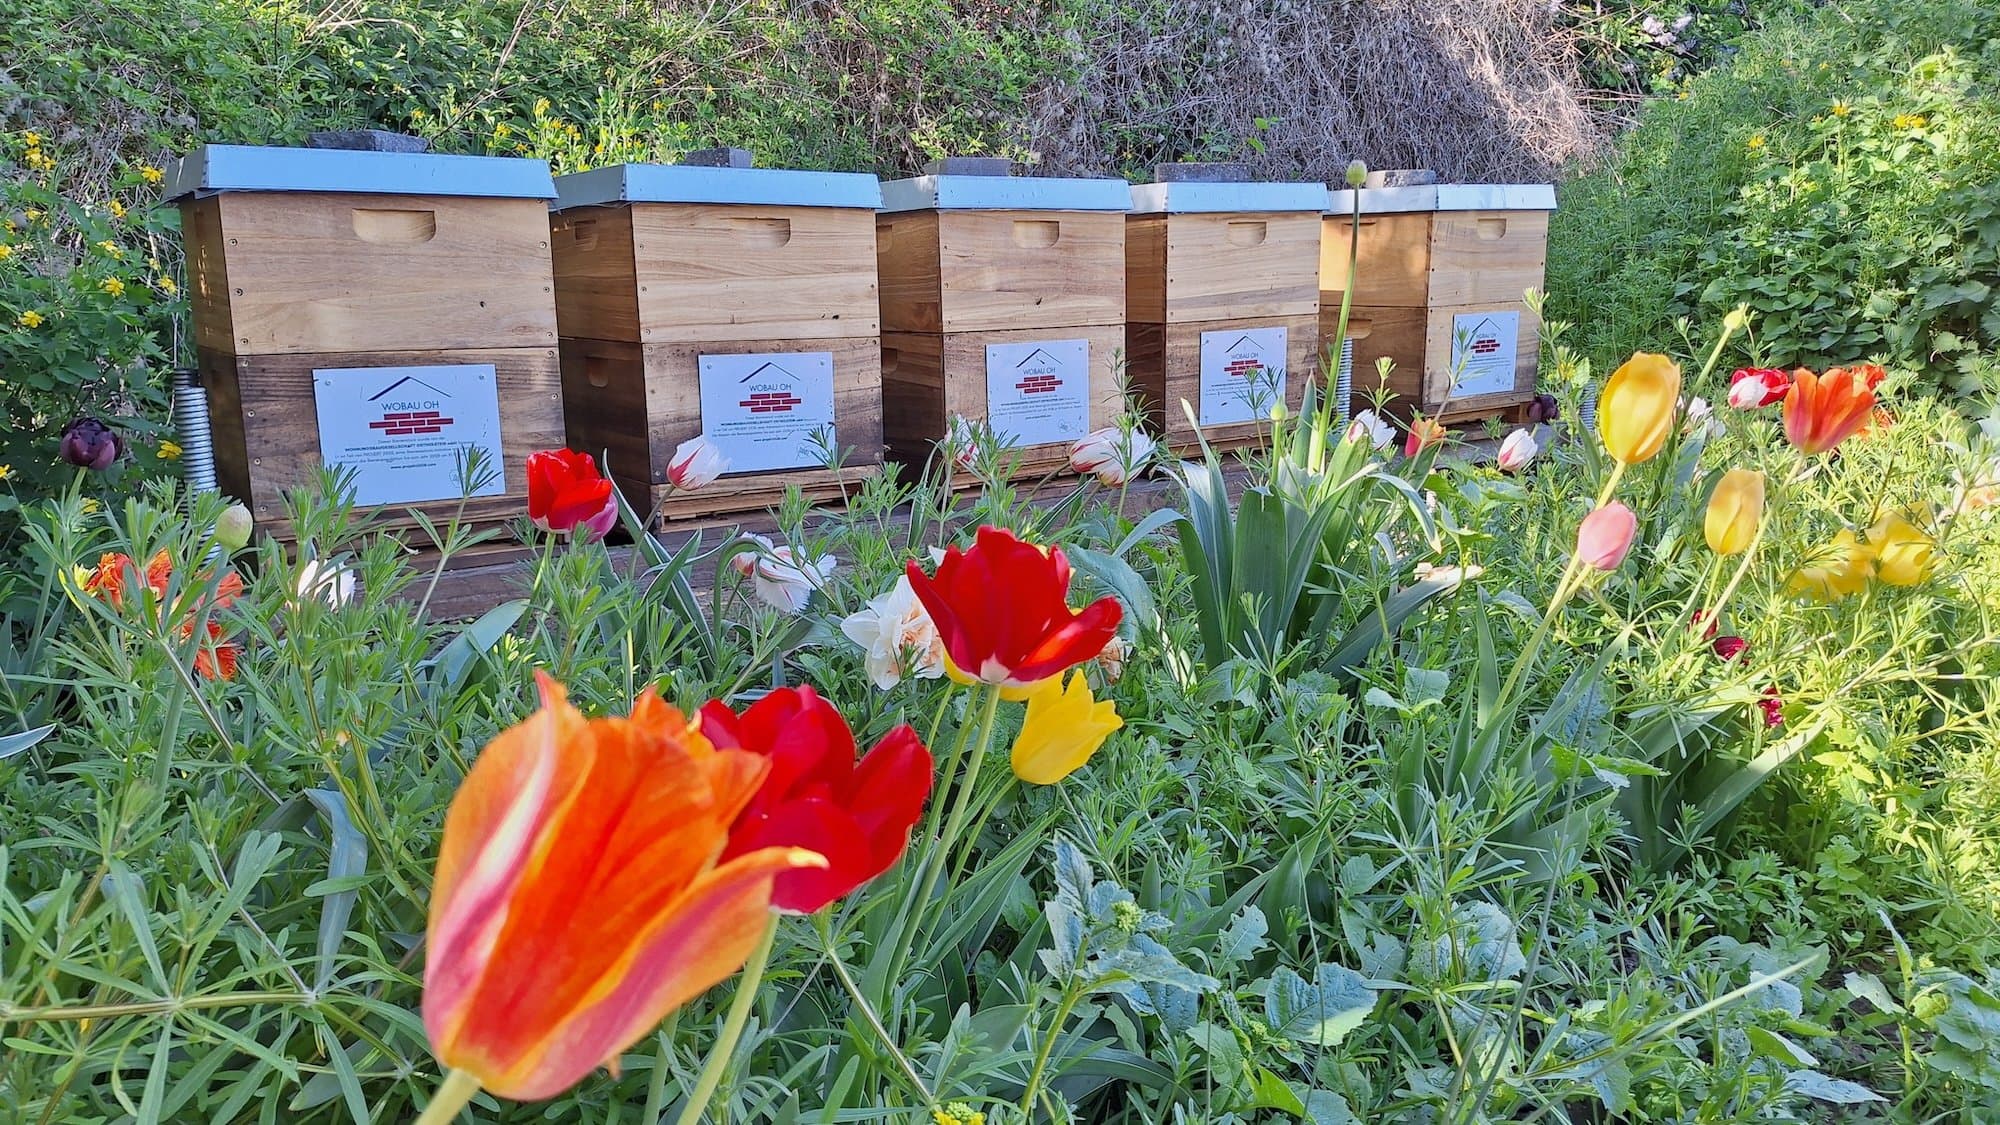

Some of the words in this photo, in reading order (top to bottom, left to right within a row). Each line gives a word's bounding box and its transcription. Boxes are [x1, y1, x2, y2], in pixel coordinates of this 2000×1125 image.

[1023, 367, 1045, 375] WOBAU
[779, 383, 792, 391] OH
[381, 401, 420, 411] WOBAU
[423, 400, 440, 410] OH
